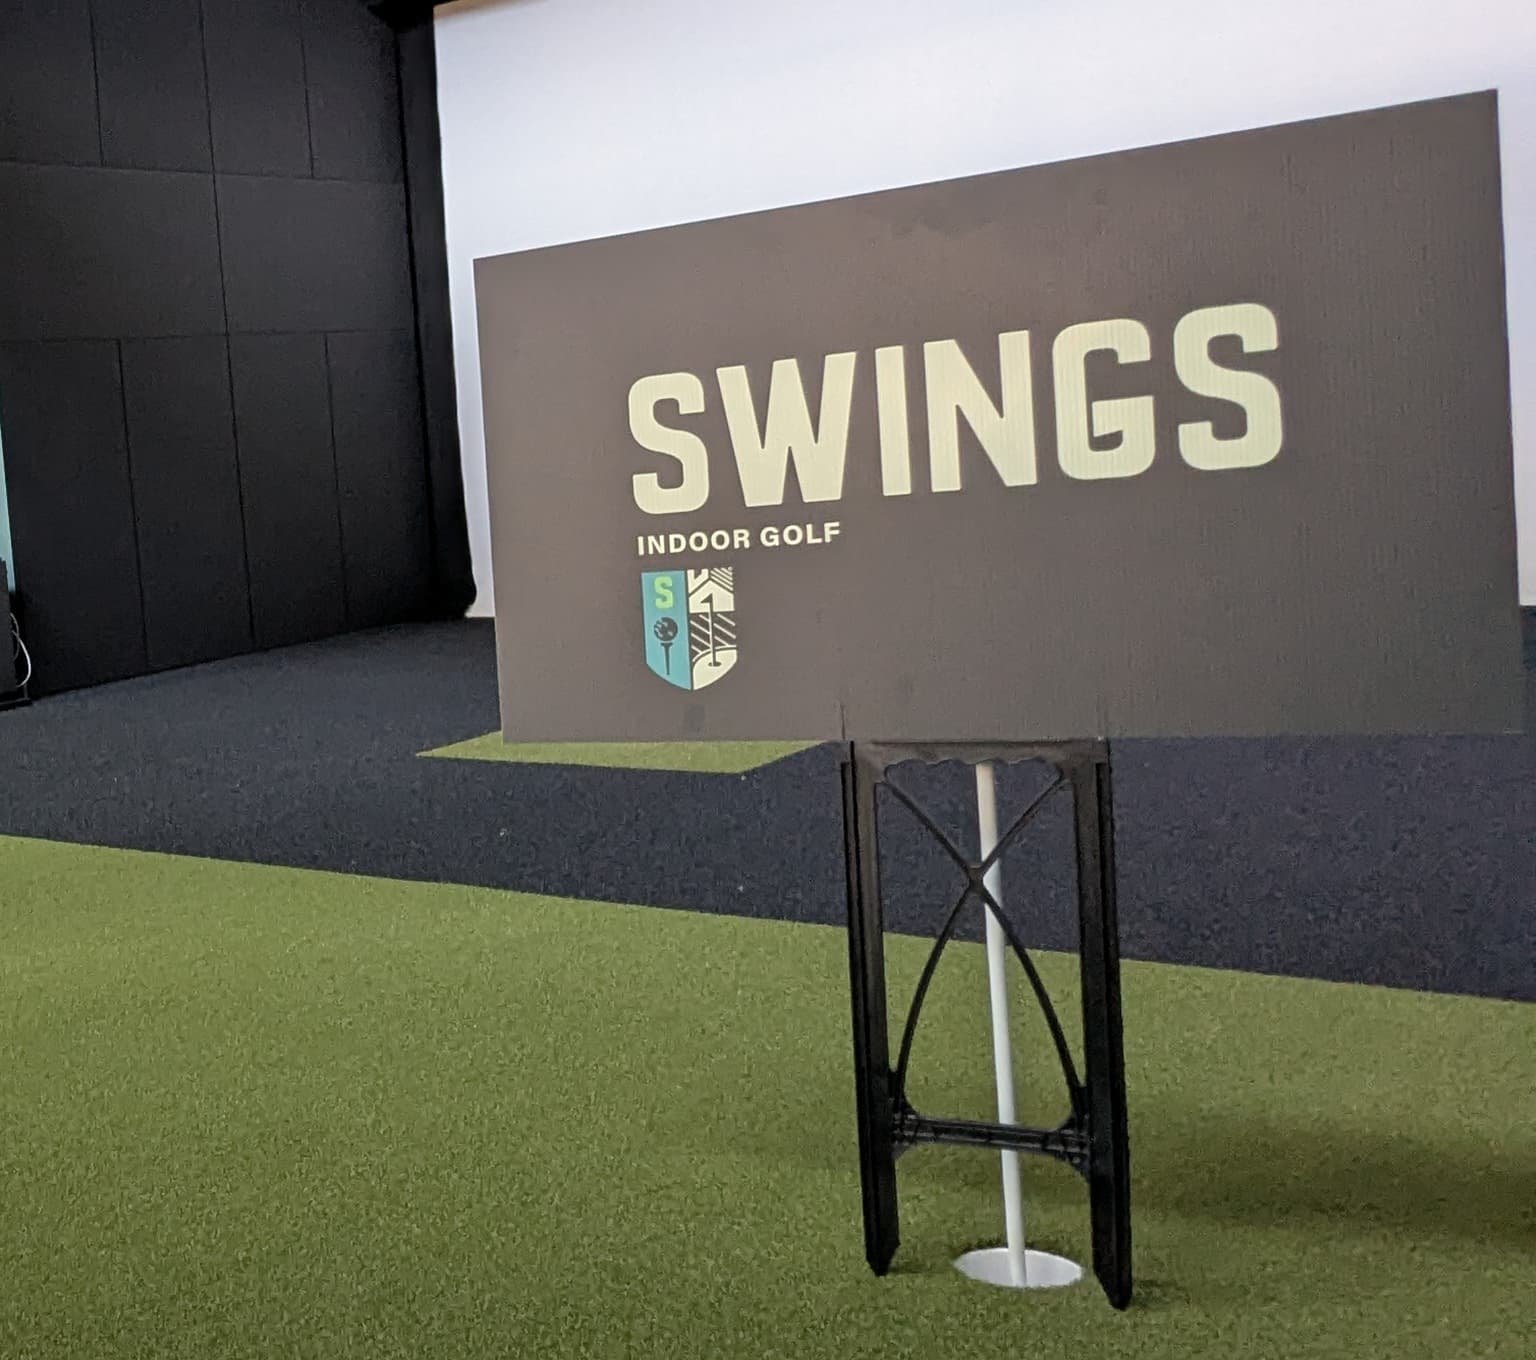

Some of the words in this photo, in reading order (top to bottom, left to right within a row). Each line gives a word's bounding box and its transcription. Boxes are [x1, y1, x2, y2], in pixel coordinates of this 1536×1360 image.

[628, 302, 1283, 514] SWINGS
[637, 528, 750, 556] INDOOR
[760, 521, 841, 547] GOLF
